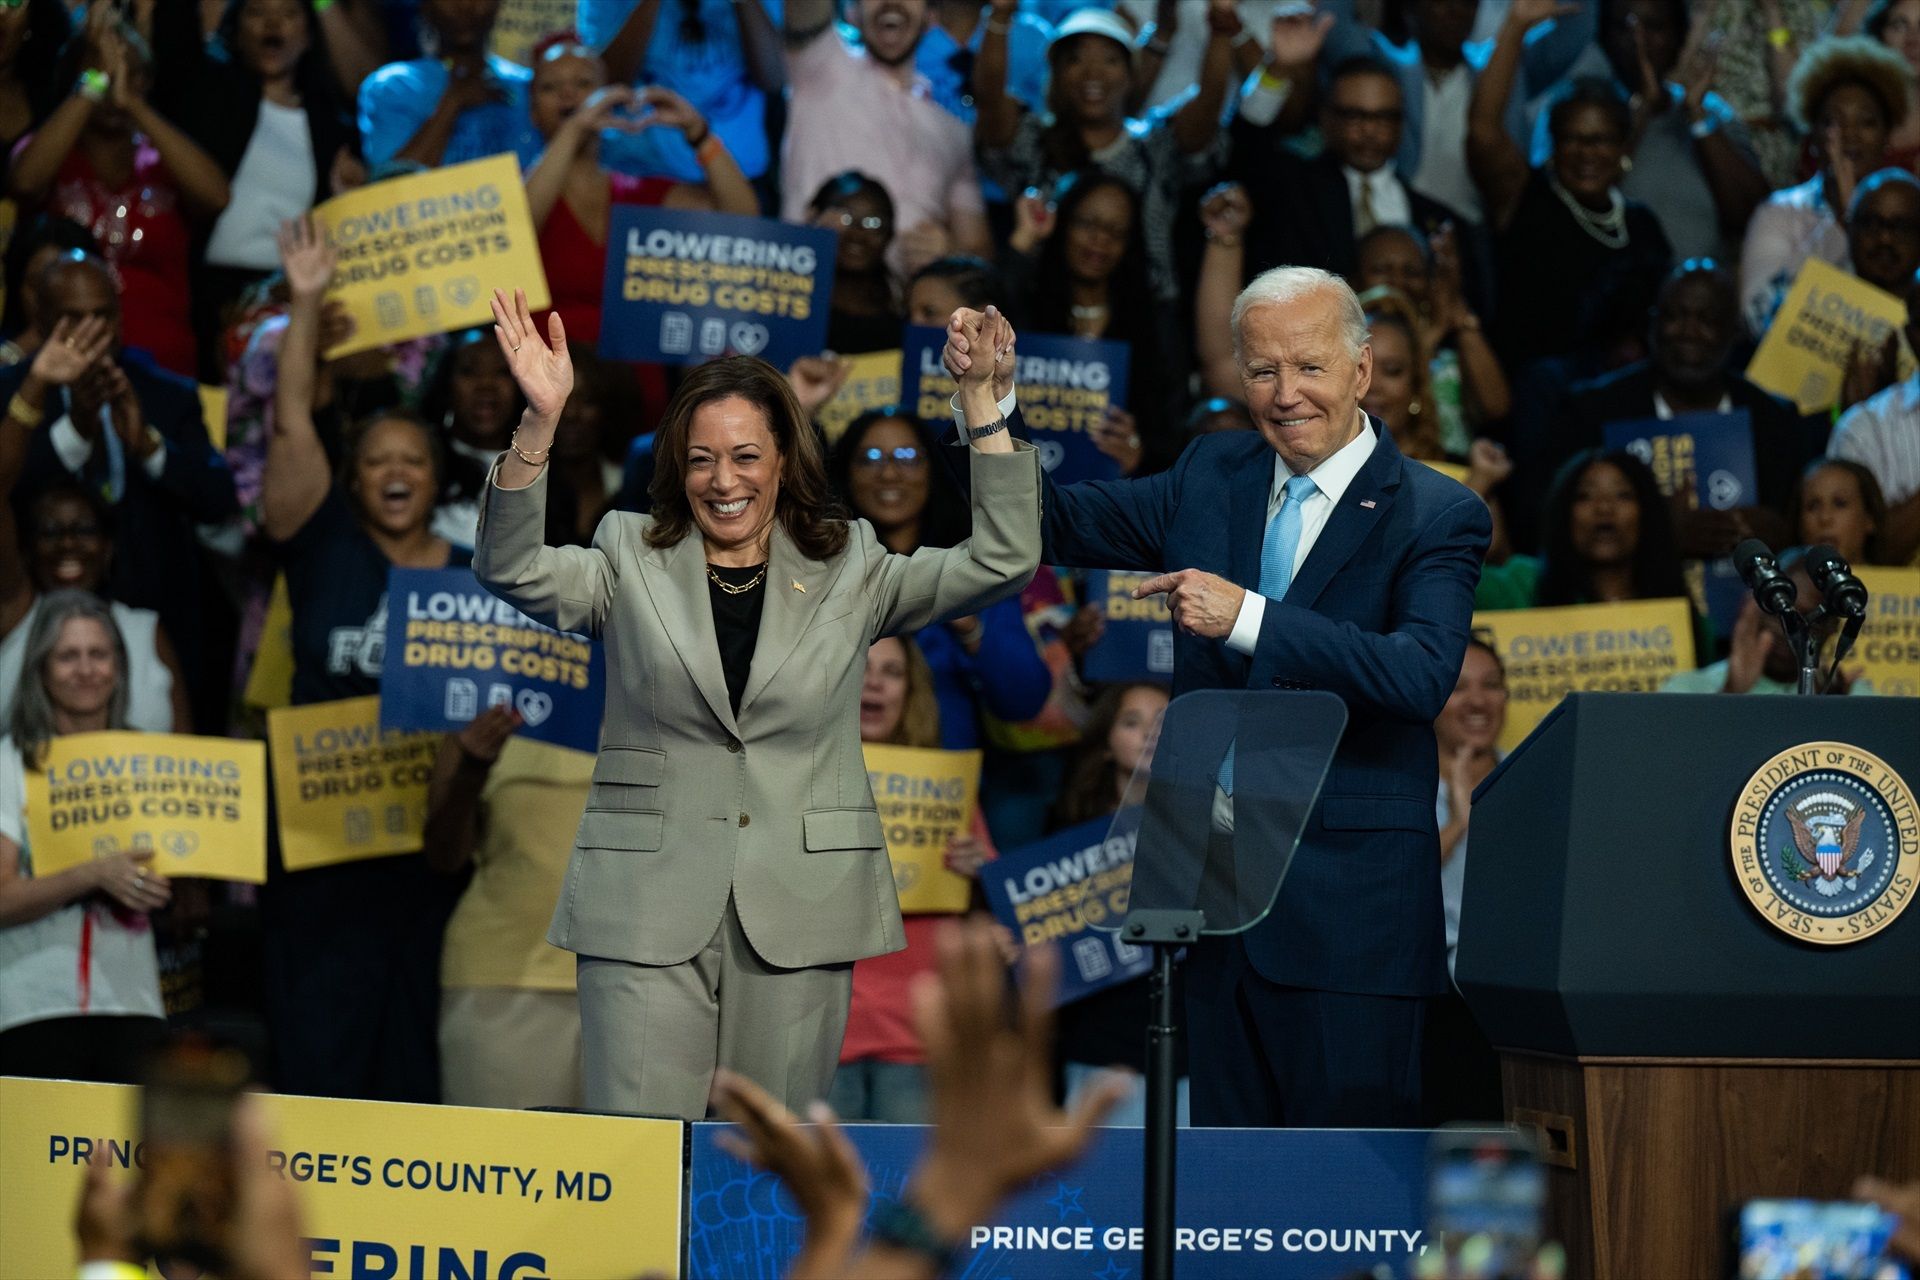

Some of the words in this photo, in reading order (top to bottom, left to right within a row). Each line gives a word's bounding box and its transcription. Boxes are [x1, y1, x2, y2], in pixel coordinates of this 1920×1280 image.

[414, 230, 512, 270] COSTS
[627, 227, 817, 275] LOWERING
[623, 276, 710, 307] DRUG
[714, 284, 811, 320] COSTS
[405, 619, 592, 665] PRESCRIPTION
[404, 641, 496, 670] DRUG
[501, 648, 590, 690] COSTS
[47, 754, 241, 787] LOWERING
[1826, 751, 1845, 765] OF
[1848, 756, 1873, 776] THE
[49, 777, 241, 804] PRESCRIPTION
[300, 769, 383, 803] DRUG
[1737, 749, 1821, 838] PRESIDENT
[50, 799, 132, 832] DRUG
[140, 797, 241, 823] COSTS
[1877, 774, 1919, 855] UNITED
[1741, 845, 1756, 873] THE
[1749, 875, 1764, 894] OF
[1847, 874, 1912, 935] STATES
[1764, 893, 1814, 934] SEAL
[265, 1150, 373, 1187] RGE'S
[382, 1157, 544, 1204] COUNTY,
[555, 1169, 614, 1203] MD
[970, 1226, 1094, 1249] PRINCE
[1102, 1227, 1274, 1251] GERGE'S
[1282, 1228, 1429, 1257] COUNTY,
